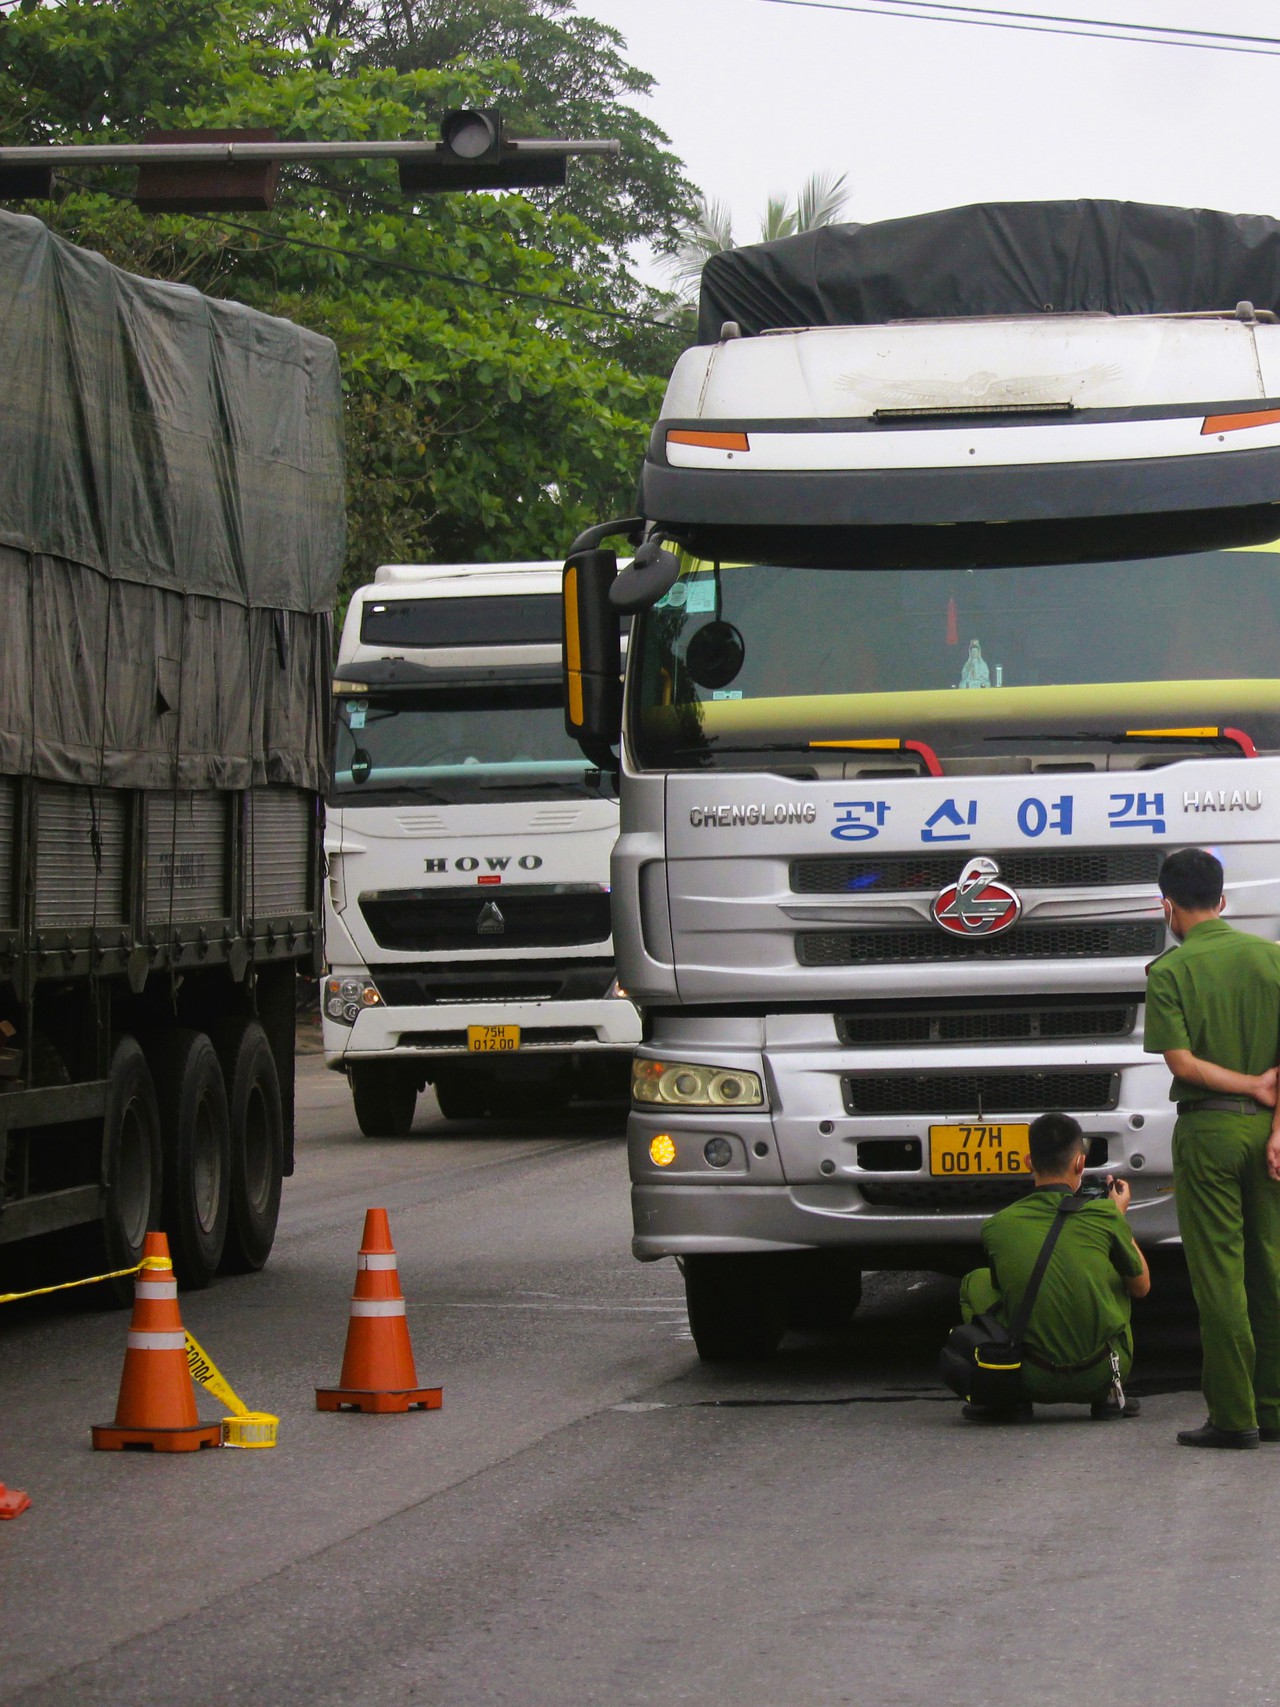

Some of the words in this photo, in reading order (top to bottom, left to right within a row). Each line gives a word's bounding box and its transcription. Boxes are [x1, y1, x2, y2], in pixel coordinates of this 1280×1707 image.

[1183, 789, 1263, 813] HAIAU
[690, 802, 817, 828] CHENGLONG
[423, 855, 543, 873] HOWO
[483, 1026, 505, 1038] 75H
[473, 1038, 514, 1051] 012.00
[959, 1126, 1002, 1148] 77H
[942, 1150, 1021, 1172] 001.16
